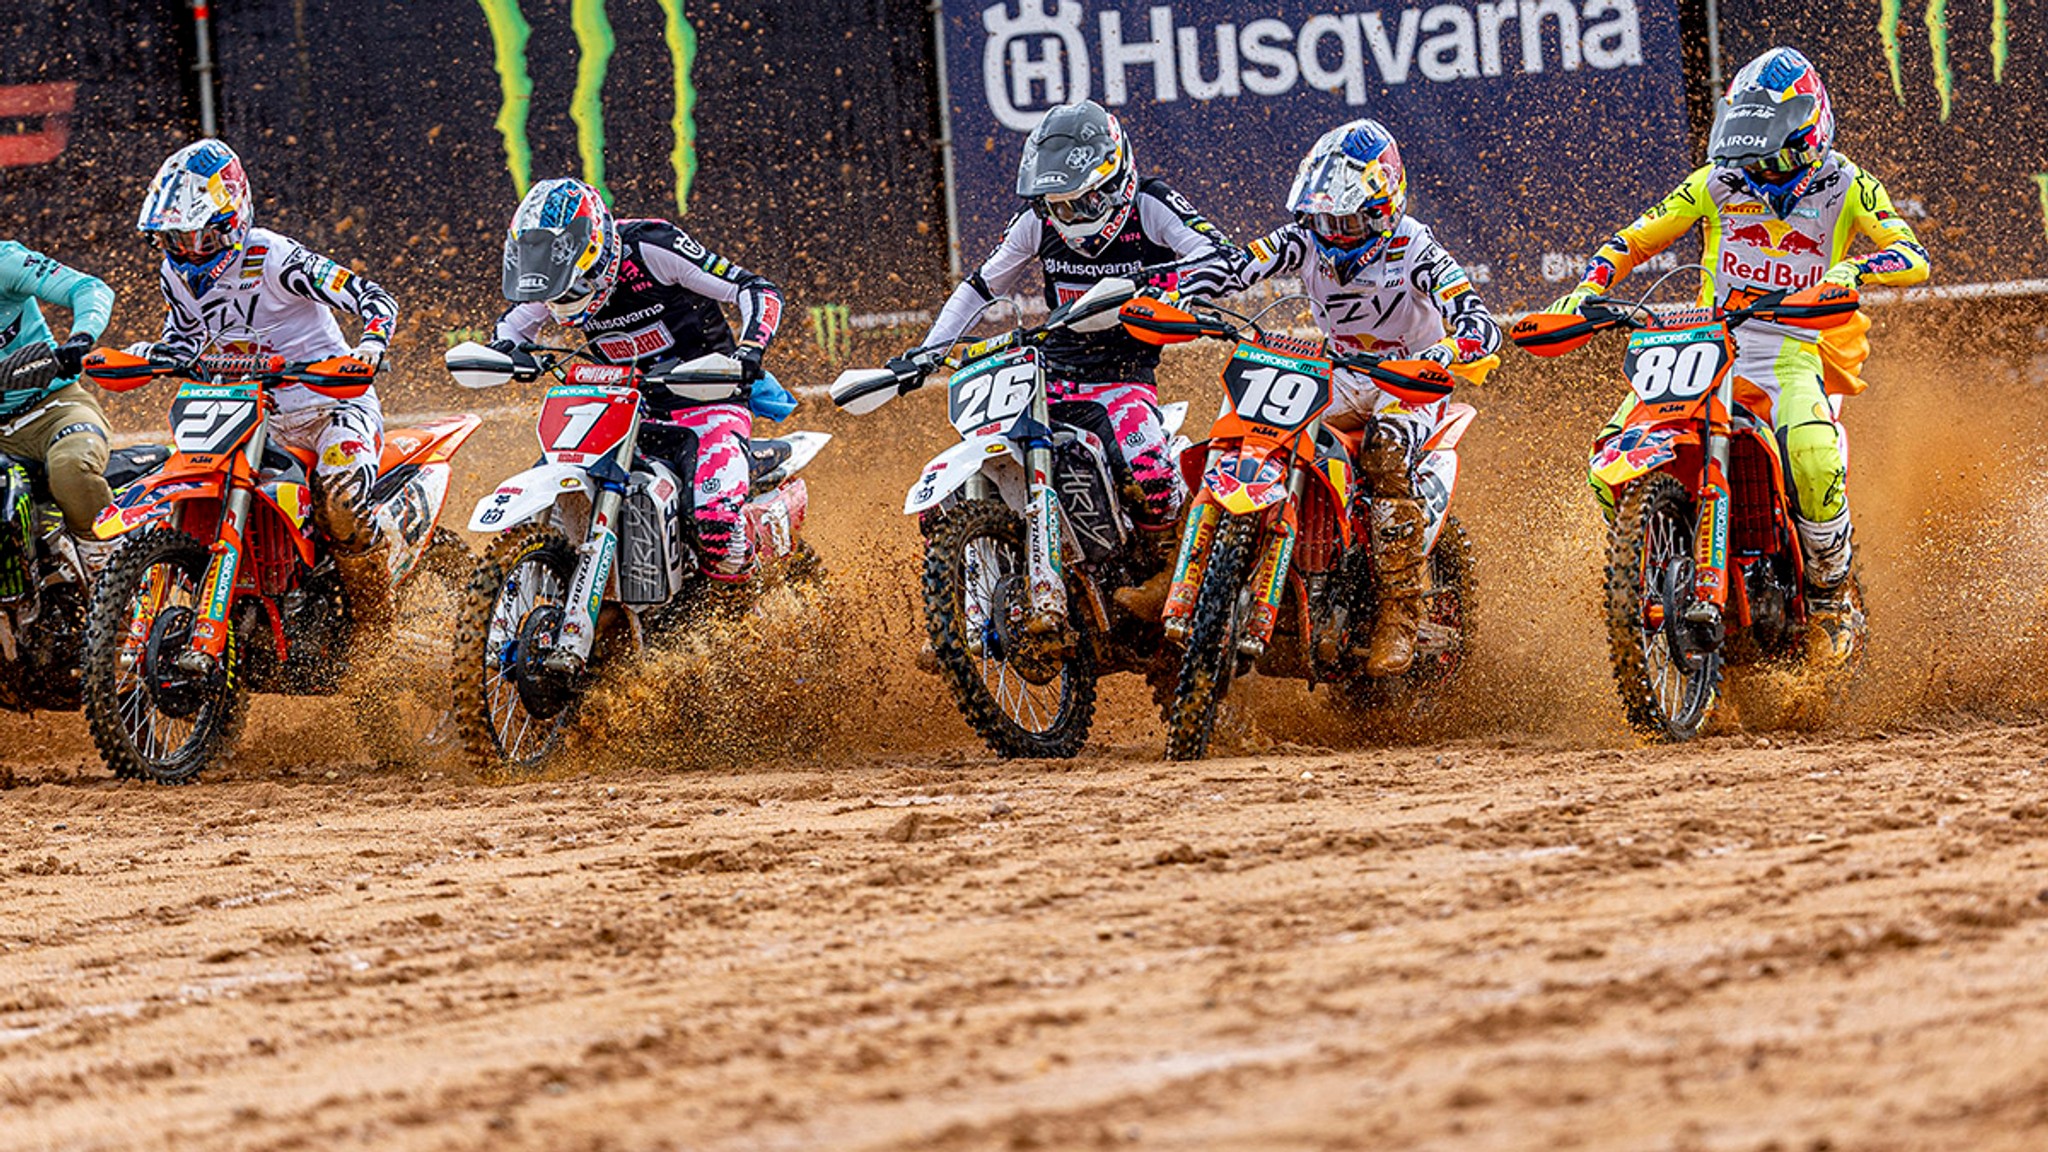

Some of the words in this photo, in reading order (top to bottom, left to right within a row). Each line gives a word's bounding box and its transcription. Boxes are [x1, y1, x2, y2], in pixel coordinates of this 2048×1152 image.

[1101, 0, 1642, 104] Husqvarna
[1719, 135, 1768, 148] AIROH
[1034, 174, 1064, 186] BELL
[1056, 260, 1142, 277] Husqvarna
[1723, 251, 1772, 283] Red
[1773, 263, 1823, 289] Bull
[519, 277, 545, 288] BELL
[1819, 289, 1850, 301] KTM
[589, 302, 665, 331] Husqvarna
[1320, 291, 1406, 330] FLY
[1512, 321, 1538, 334] KTM
[1643, 332, 1692, 345] MOTOREX
[1249, 351, 1299, 369] MOTOREX
[338, 365, 368, 375] KTM
[1418, 371, 1449, 383] KTM
[1631, 342, 1720, 400] 80
[190, 388, 231, 397] MOTOREX
[954, 362, 1037, 431] 26
[1236, 366, 1319, 425] 19
[1658, 403, 1684, 413] KTM
[174, 401, 255, 451] 27
[551, 401, 610, 450] 1
[1251, 425, 1279, 438] KTM
[190, 455, 213, 464] KTM
[1715, 497, 1729, 551] MOTOREX
[216, 549, 236, 602] MOTOREX
[572, 554, 591, 604] DUNLO
